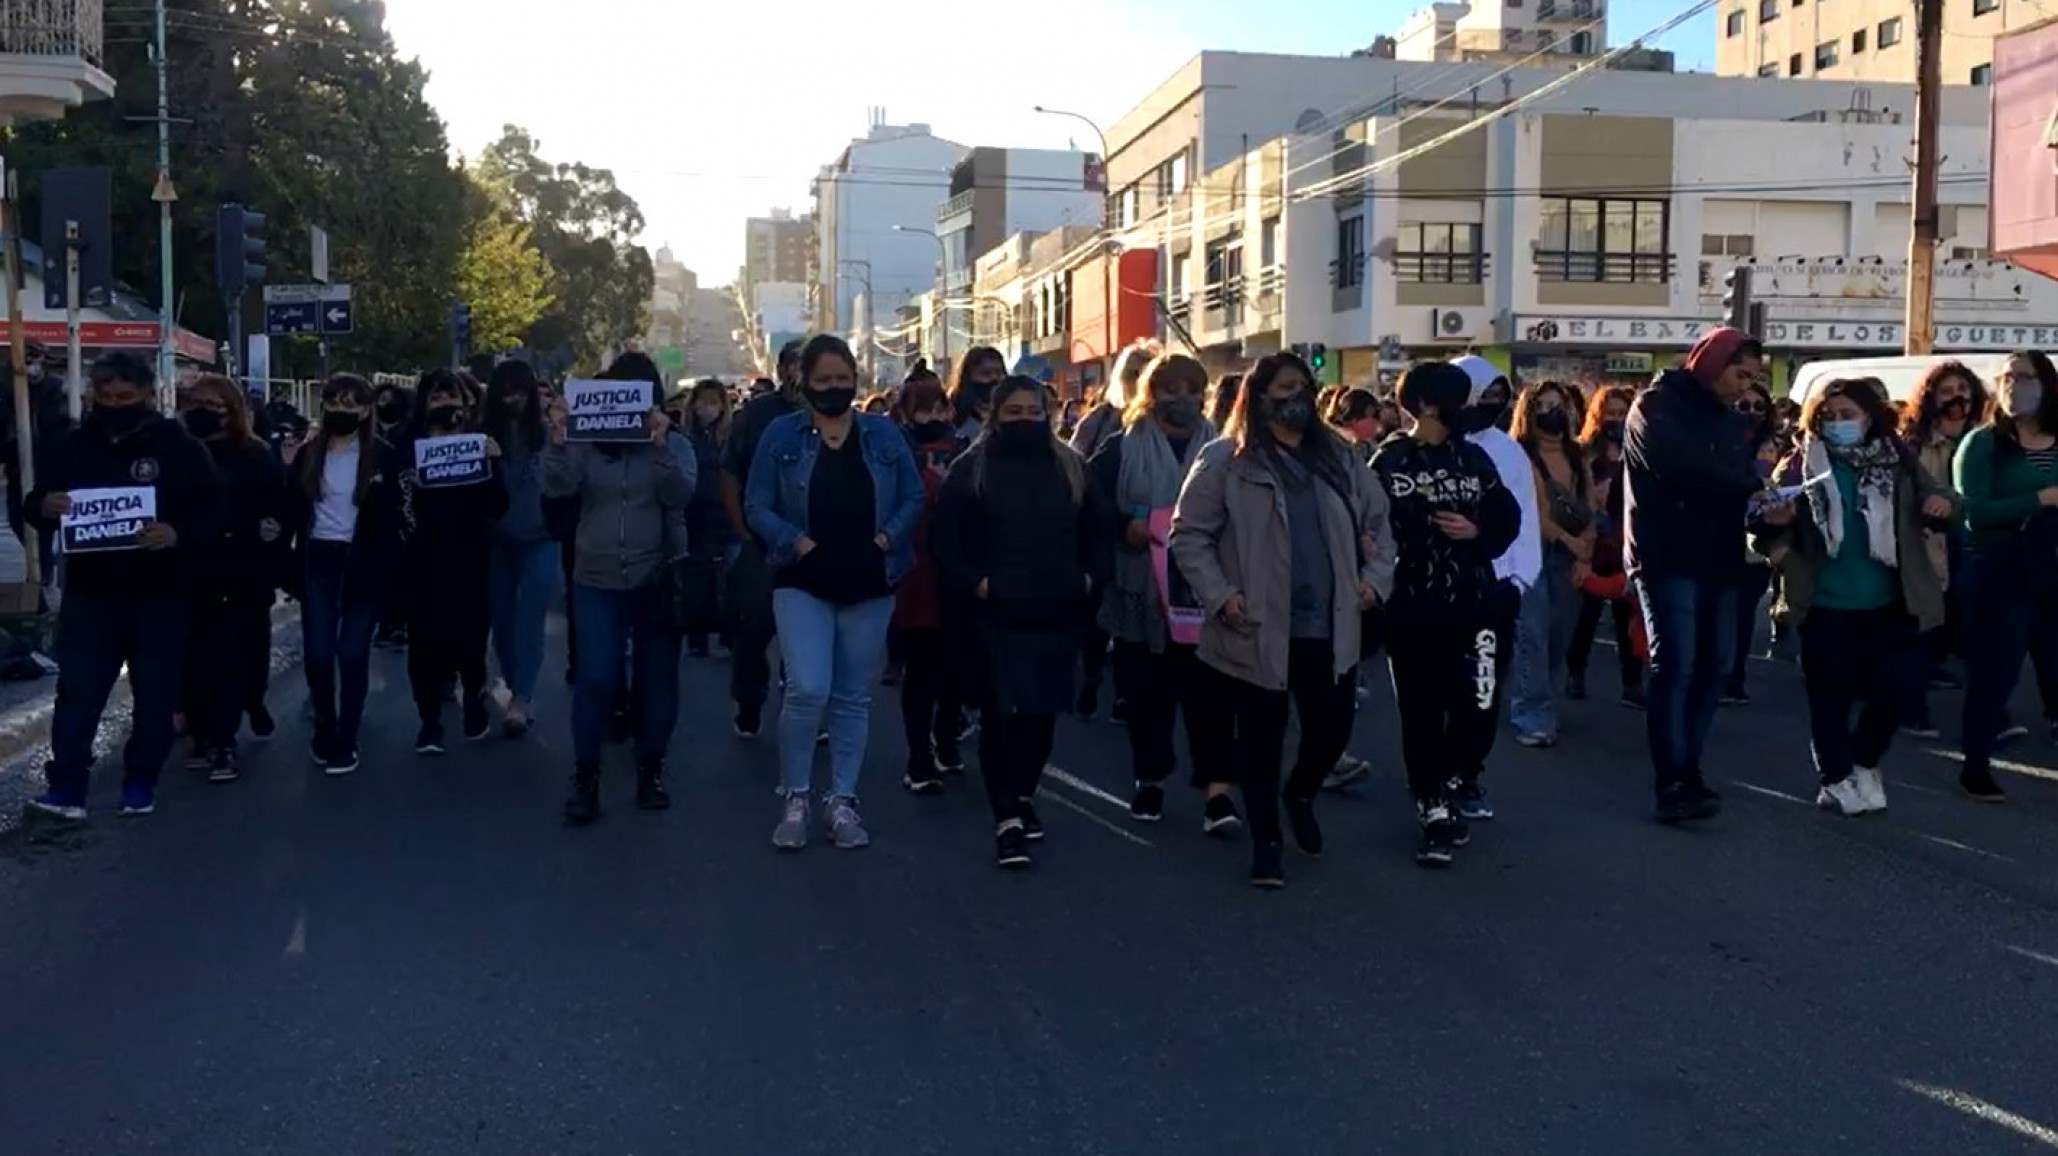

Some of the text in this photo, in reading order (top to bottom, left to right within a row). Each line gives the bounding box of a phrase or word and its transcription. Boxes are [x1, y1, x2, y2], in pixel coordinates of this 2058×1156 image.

[1569, 321, 1614, 337] EL
[1628, 321, 1703, 339] BAZ
[1766, 323, 1813, 340] DE
[1828, 324, 1897, 342] LOS
[572, 388, 642, 411] JUSTICIA
[576, 414, 642, 431] DANIELA
[422, 440, 480, 463] JUSTICIA
[426, 460, 483, 480] DANIELA
[70, 495, 143, 521] JUSTICIA
[75, 519, 144, 541] DANIELA
